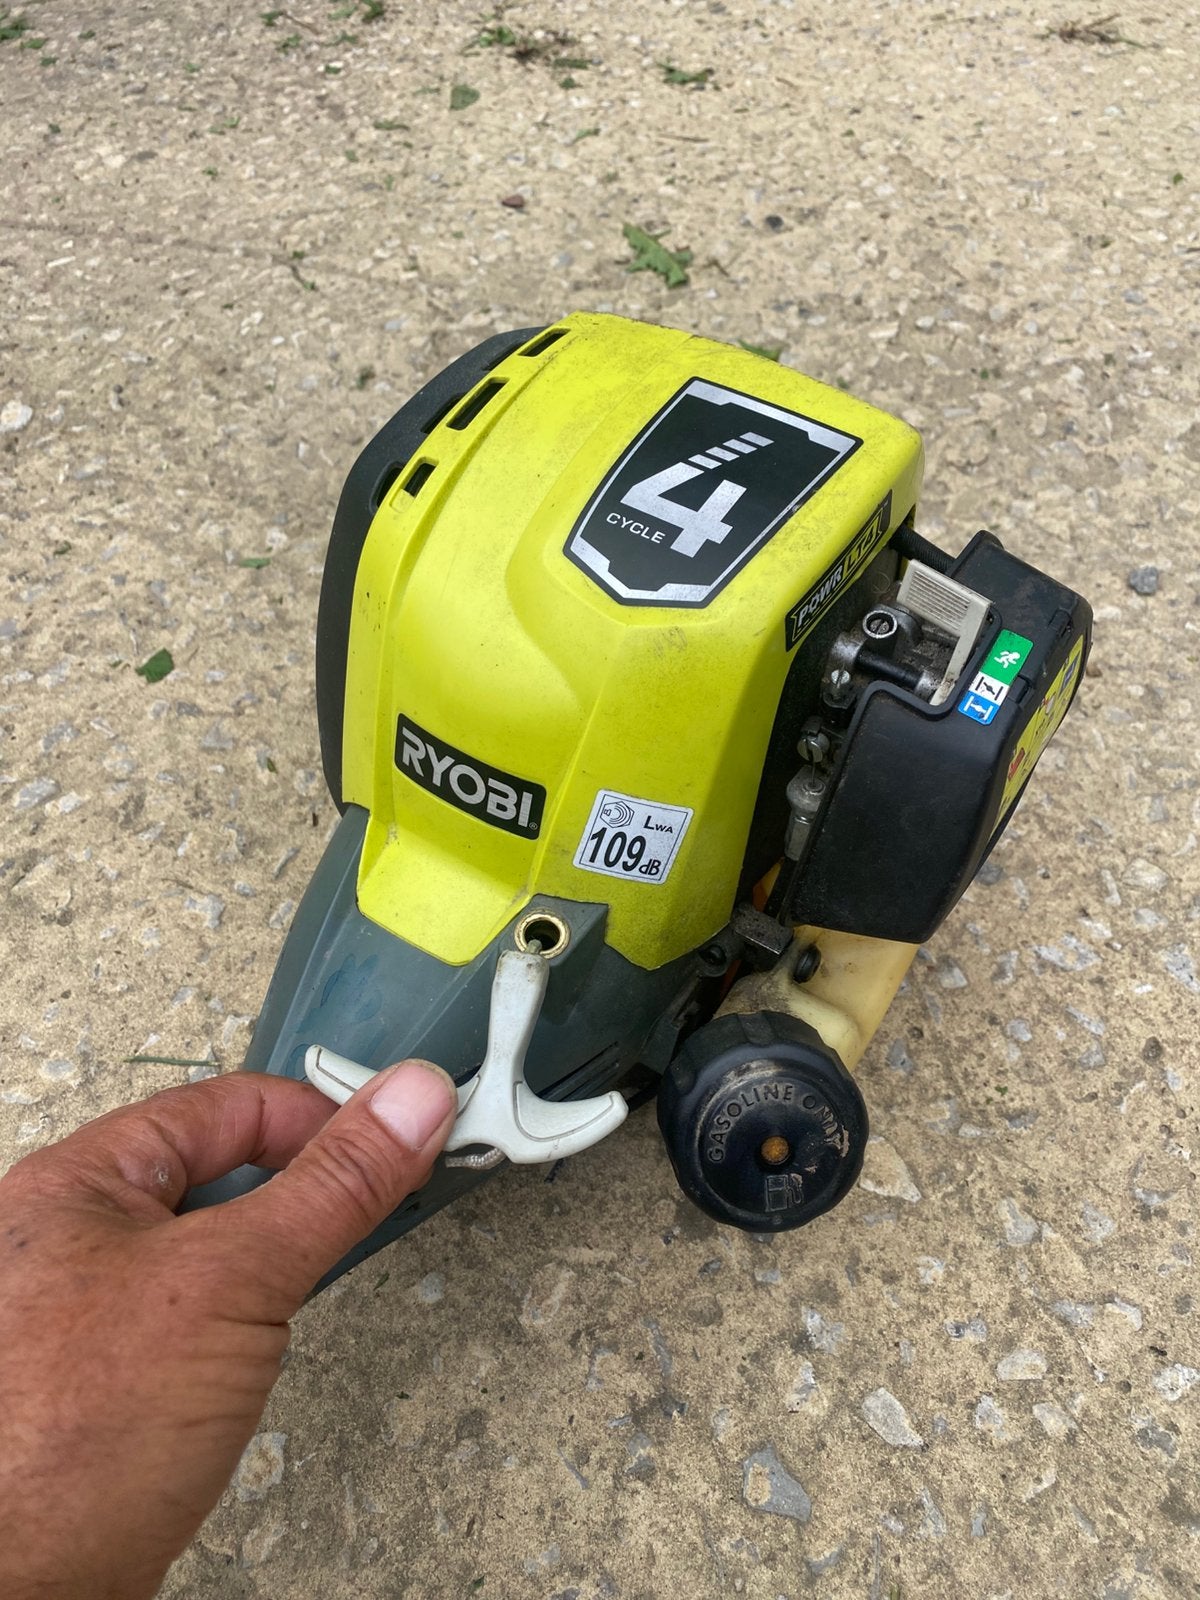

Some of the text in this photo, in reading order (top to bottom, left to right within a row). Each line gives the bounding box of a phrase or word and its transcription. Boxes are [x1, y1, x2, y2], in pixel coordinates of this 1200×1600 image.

[606, 513, 666, 544] CYCLE
[620, 462, 747, 558] 4
[798, 565, 843, 628] POWR
[402, 726, 533, 828] RYOBI
[707, 1083, 793, 1163] GASOLINE
